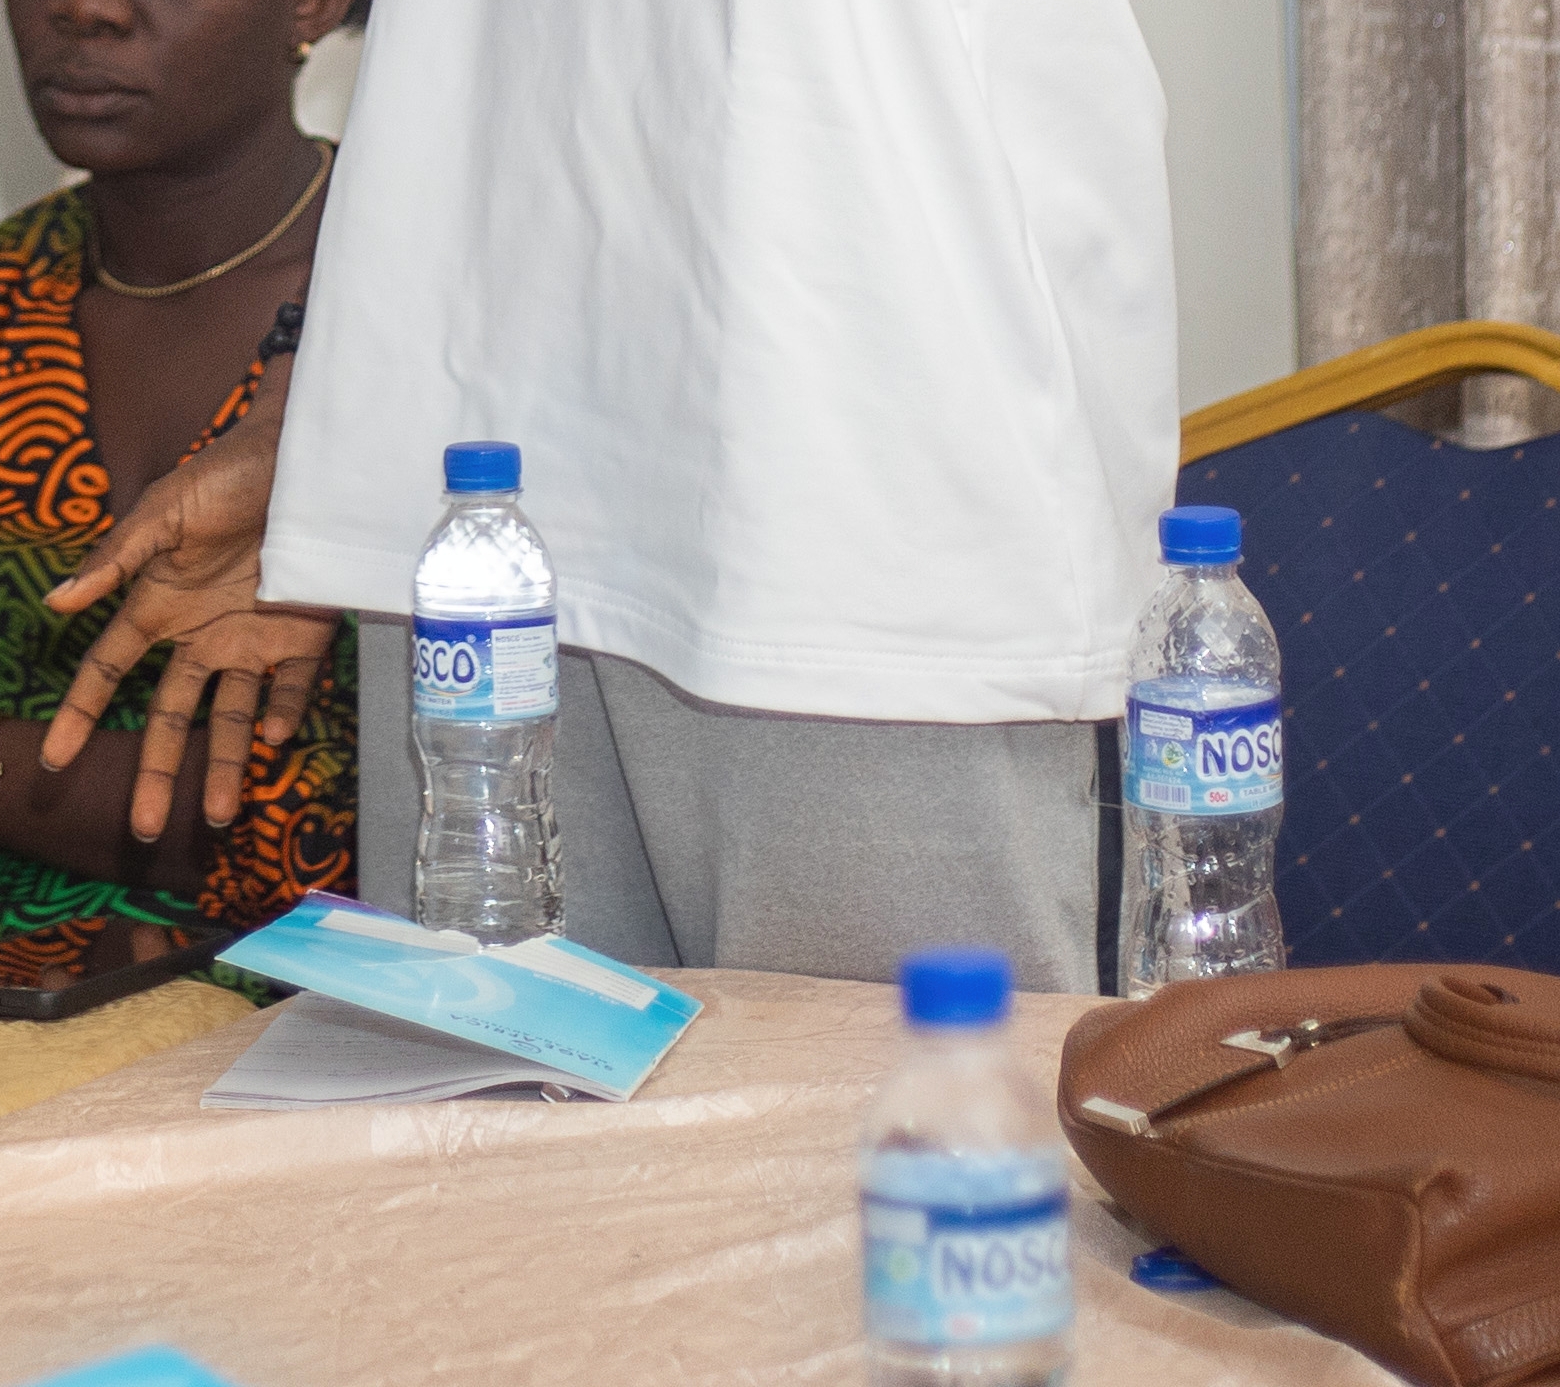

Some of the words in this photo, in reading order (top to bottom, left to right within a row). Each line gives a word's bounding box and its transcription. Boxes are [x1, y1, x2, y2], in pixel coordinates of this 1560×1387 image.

[413, 642, 475, 684] OSCO
[1201, 725, 1281, 776] NOSC
[1209, 791, 1229, 803] 50cl
[941, 1233, 1063, 1296] NOSC
